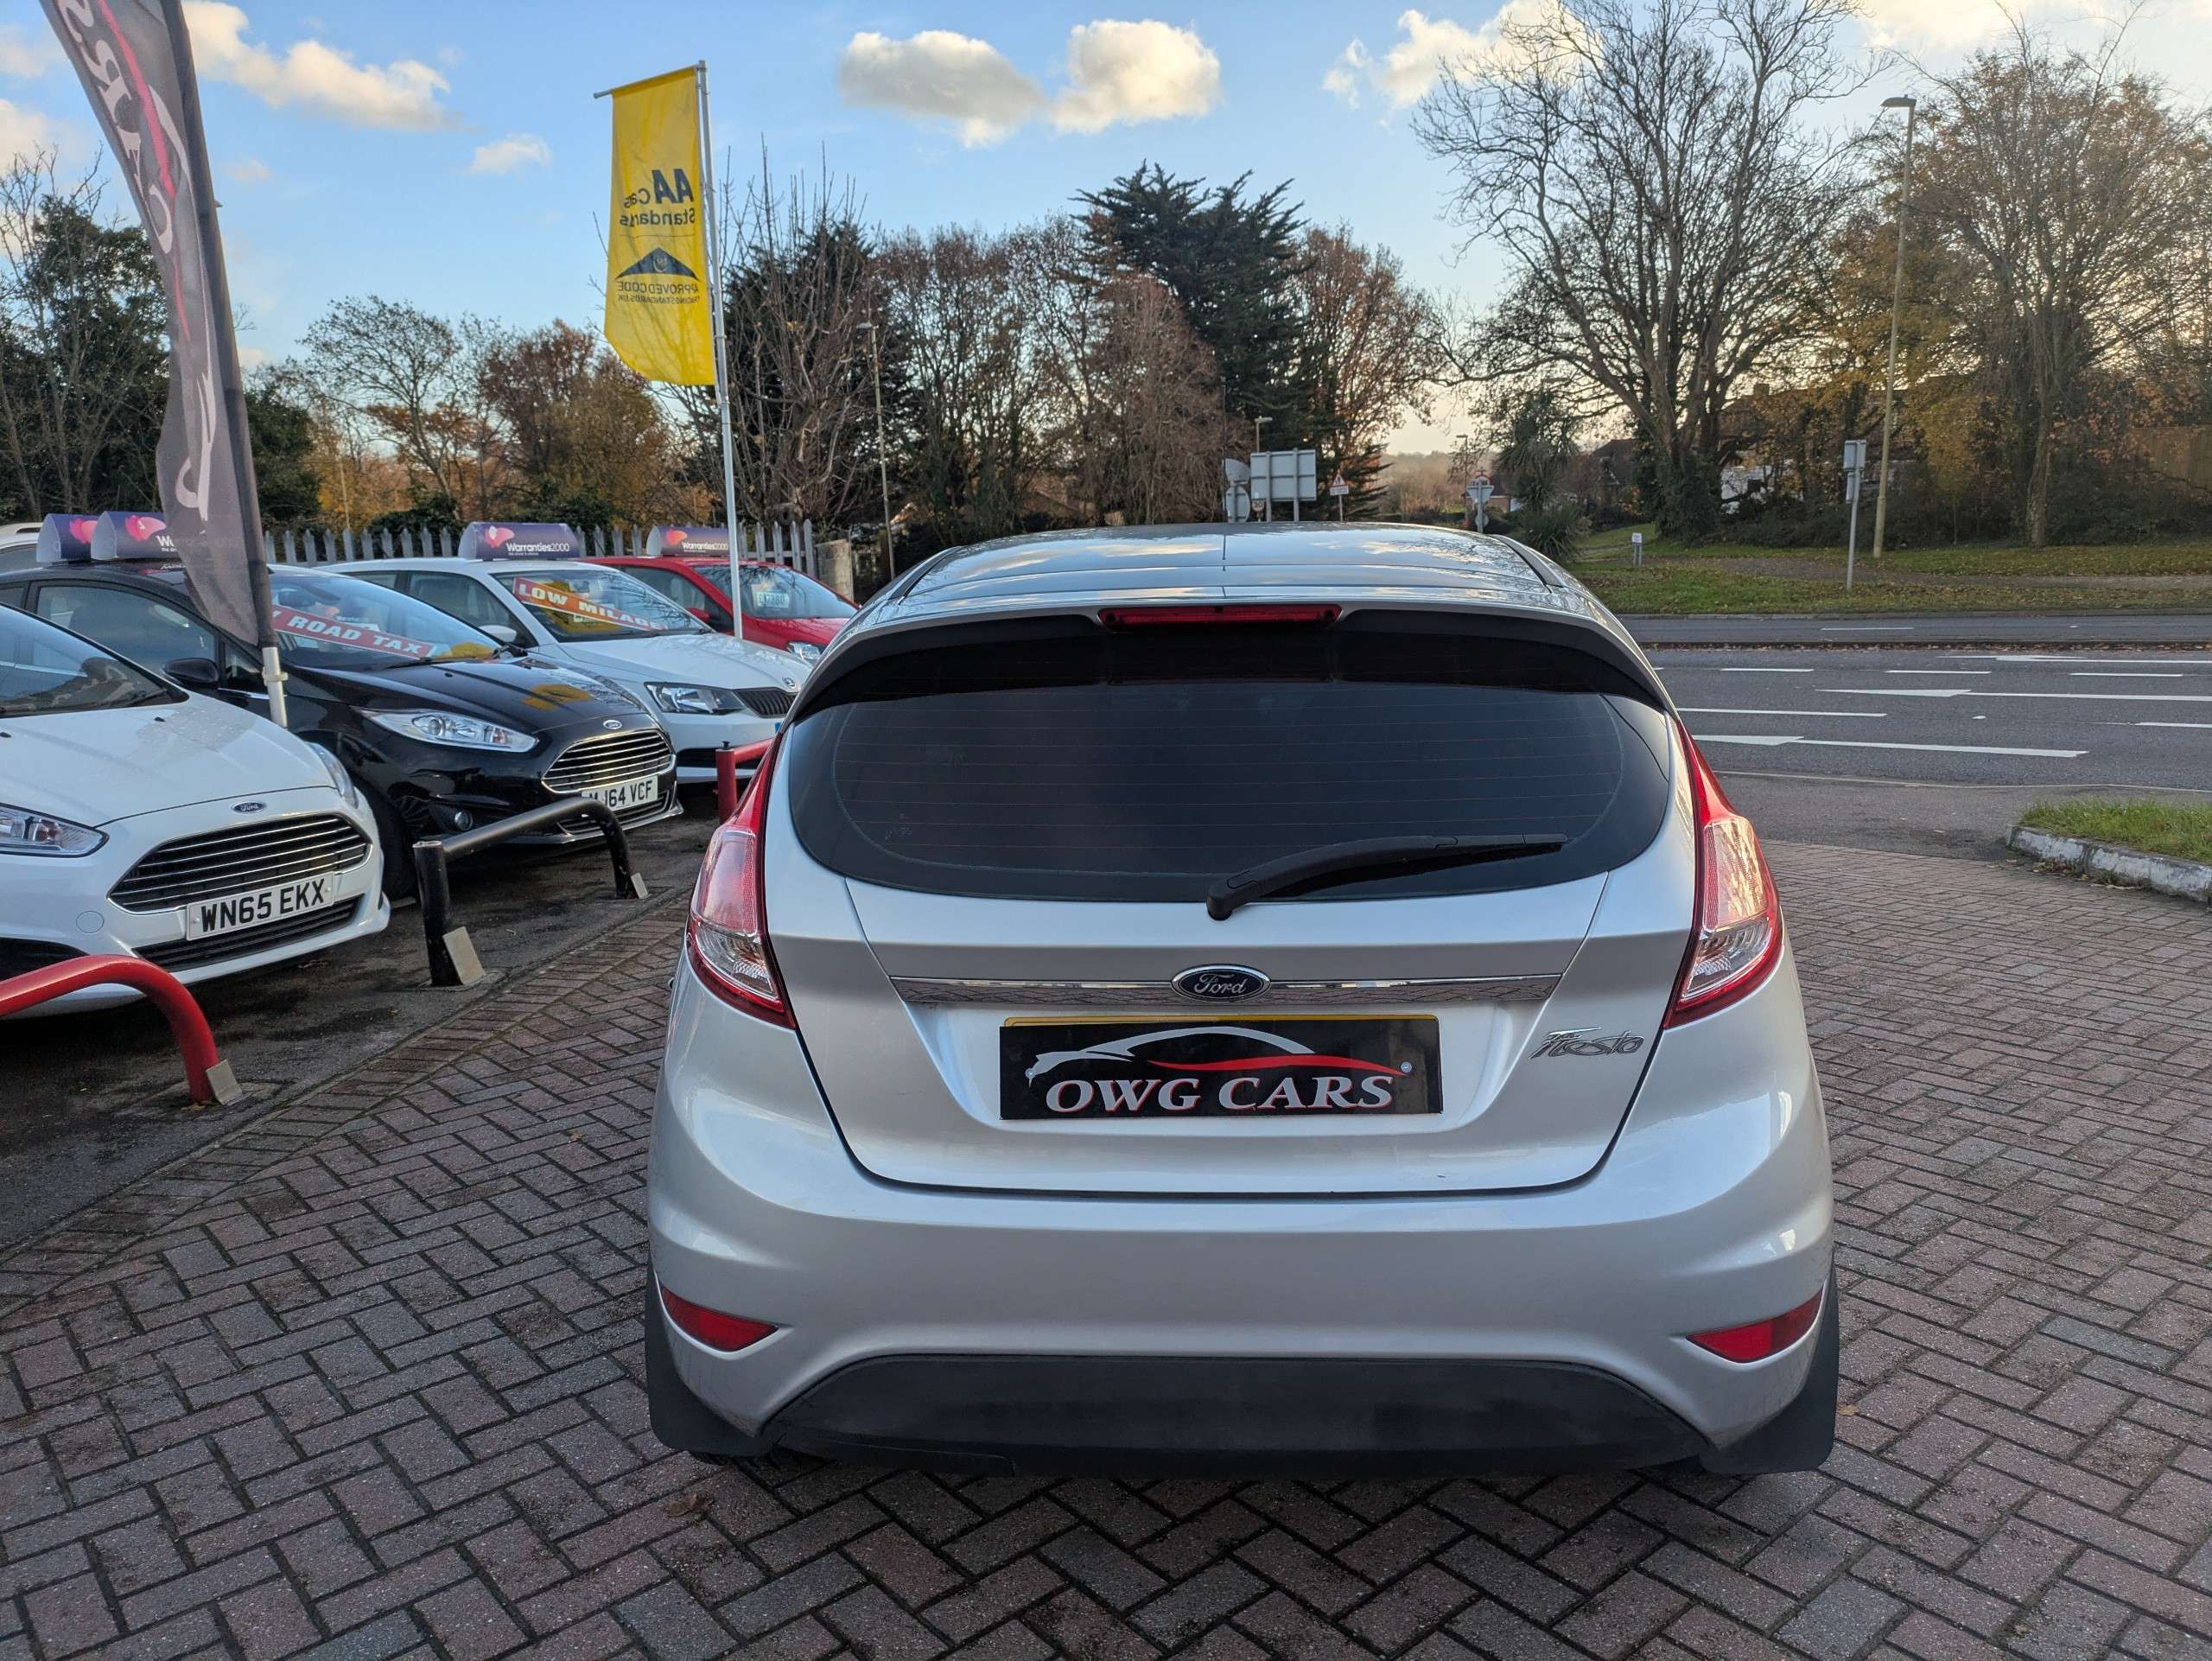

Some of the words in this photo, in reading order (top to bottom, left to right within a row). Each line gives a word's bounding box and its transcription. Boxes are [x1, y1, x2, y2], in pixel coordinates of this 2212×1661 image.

[505, 542, 570, 552] Warranties2000
[518, 583, 568, 605] LOW
[287, 614, 362, 641] ROAD
[372, 633, 423, 654] TAX
[630, 780, 652, 802] VCF
[201, 892, 272, 932] WN65
[280, 878, 325, 915] EKX
[1193, 973, 1247, 994] Ford
[1046, 1077, 1201, 1113] OWG
[1217, 1075, 1394, 1111] CARS
